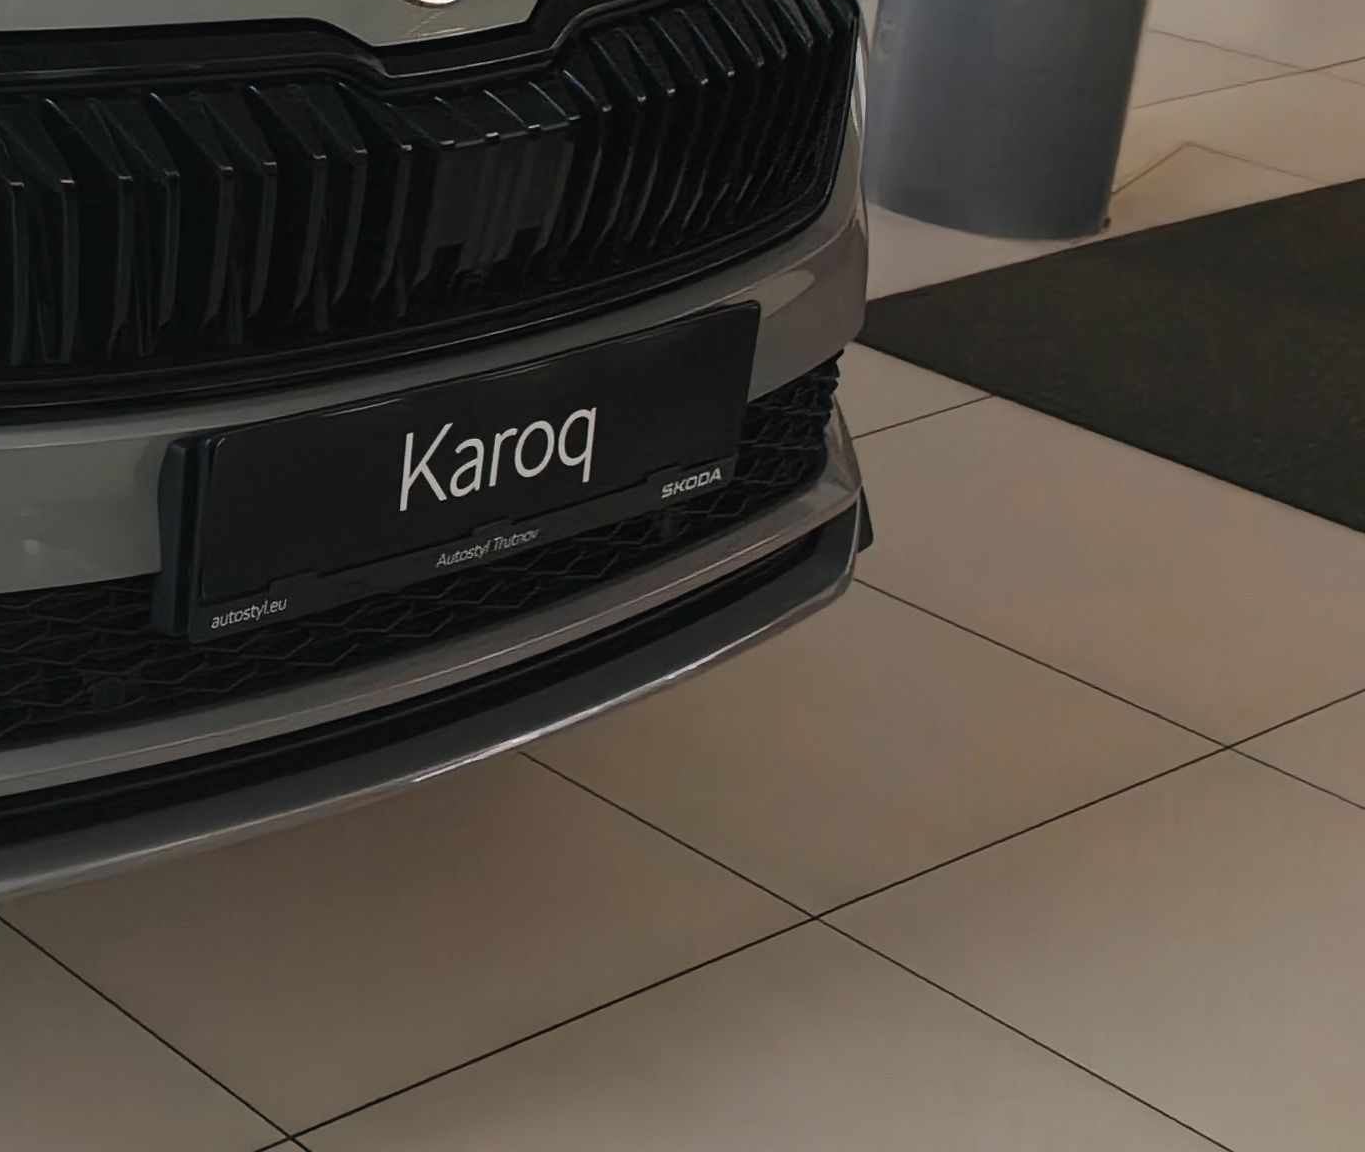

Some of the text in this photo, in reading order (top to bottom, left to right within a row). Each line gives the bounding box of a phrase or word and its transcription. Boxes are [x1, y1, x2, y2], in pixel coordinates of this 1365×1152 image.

[399, 407, 597, 512] Karoq
[435, 528, 540, 569] Autostyl Trutnov
[211, 598, 288, 629] autostyl.eu
